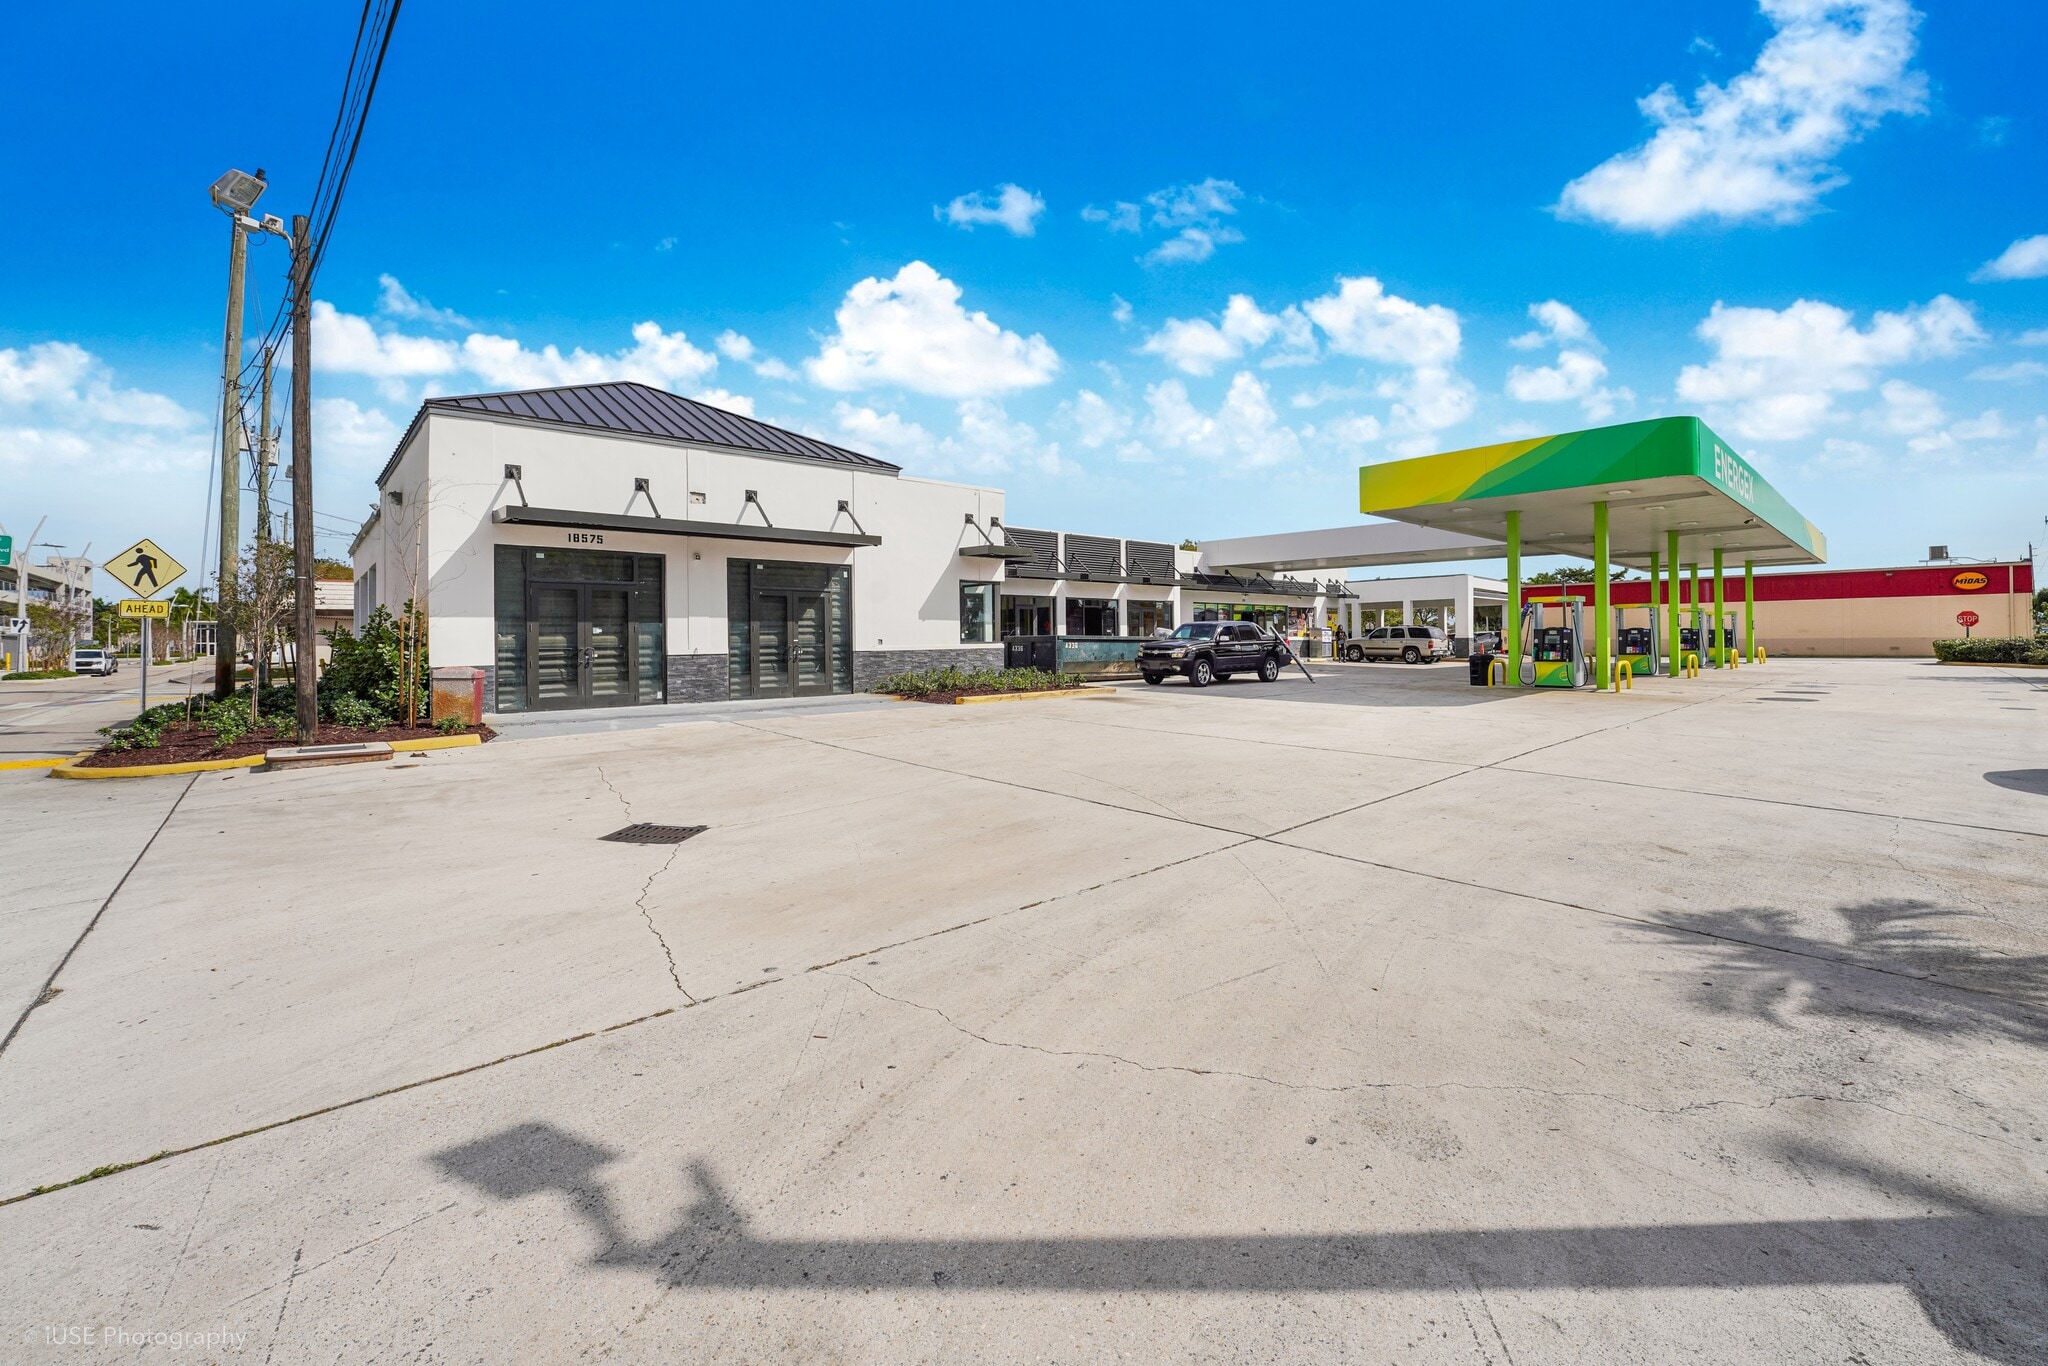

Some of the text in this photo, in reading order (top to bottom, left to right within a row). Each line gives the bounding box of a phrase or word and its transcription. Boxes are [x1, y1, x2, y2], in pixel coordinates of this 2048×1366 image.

[1714, 443, 1754, 503] ENERGEX
[568, 533, 604, 544] 18575
[1954, 576, 1987, 585] MIDAS
[126, 604, 164, 614] AHEAD
[1957, 615, 1978, 623] STOP
